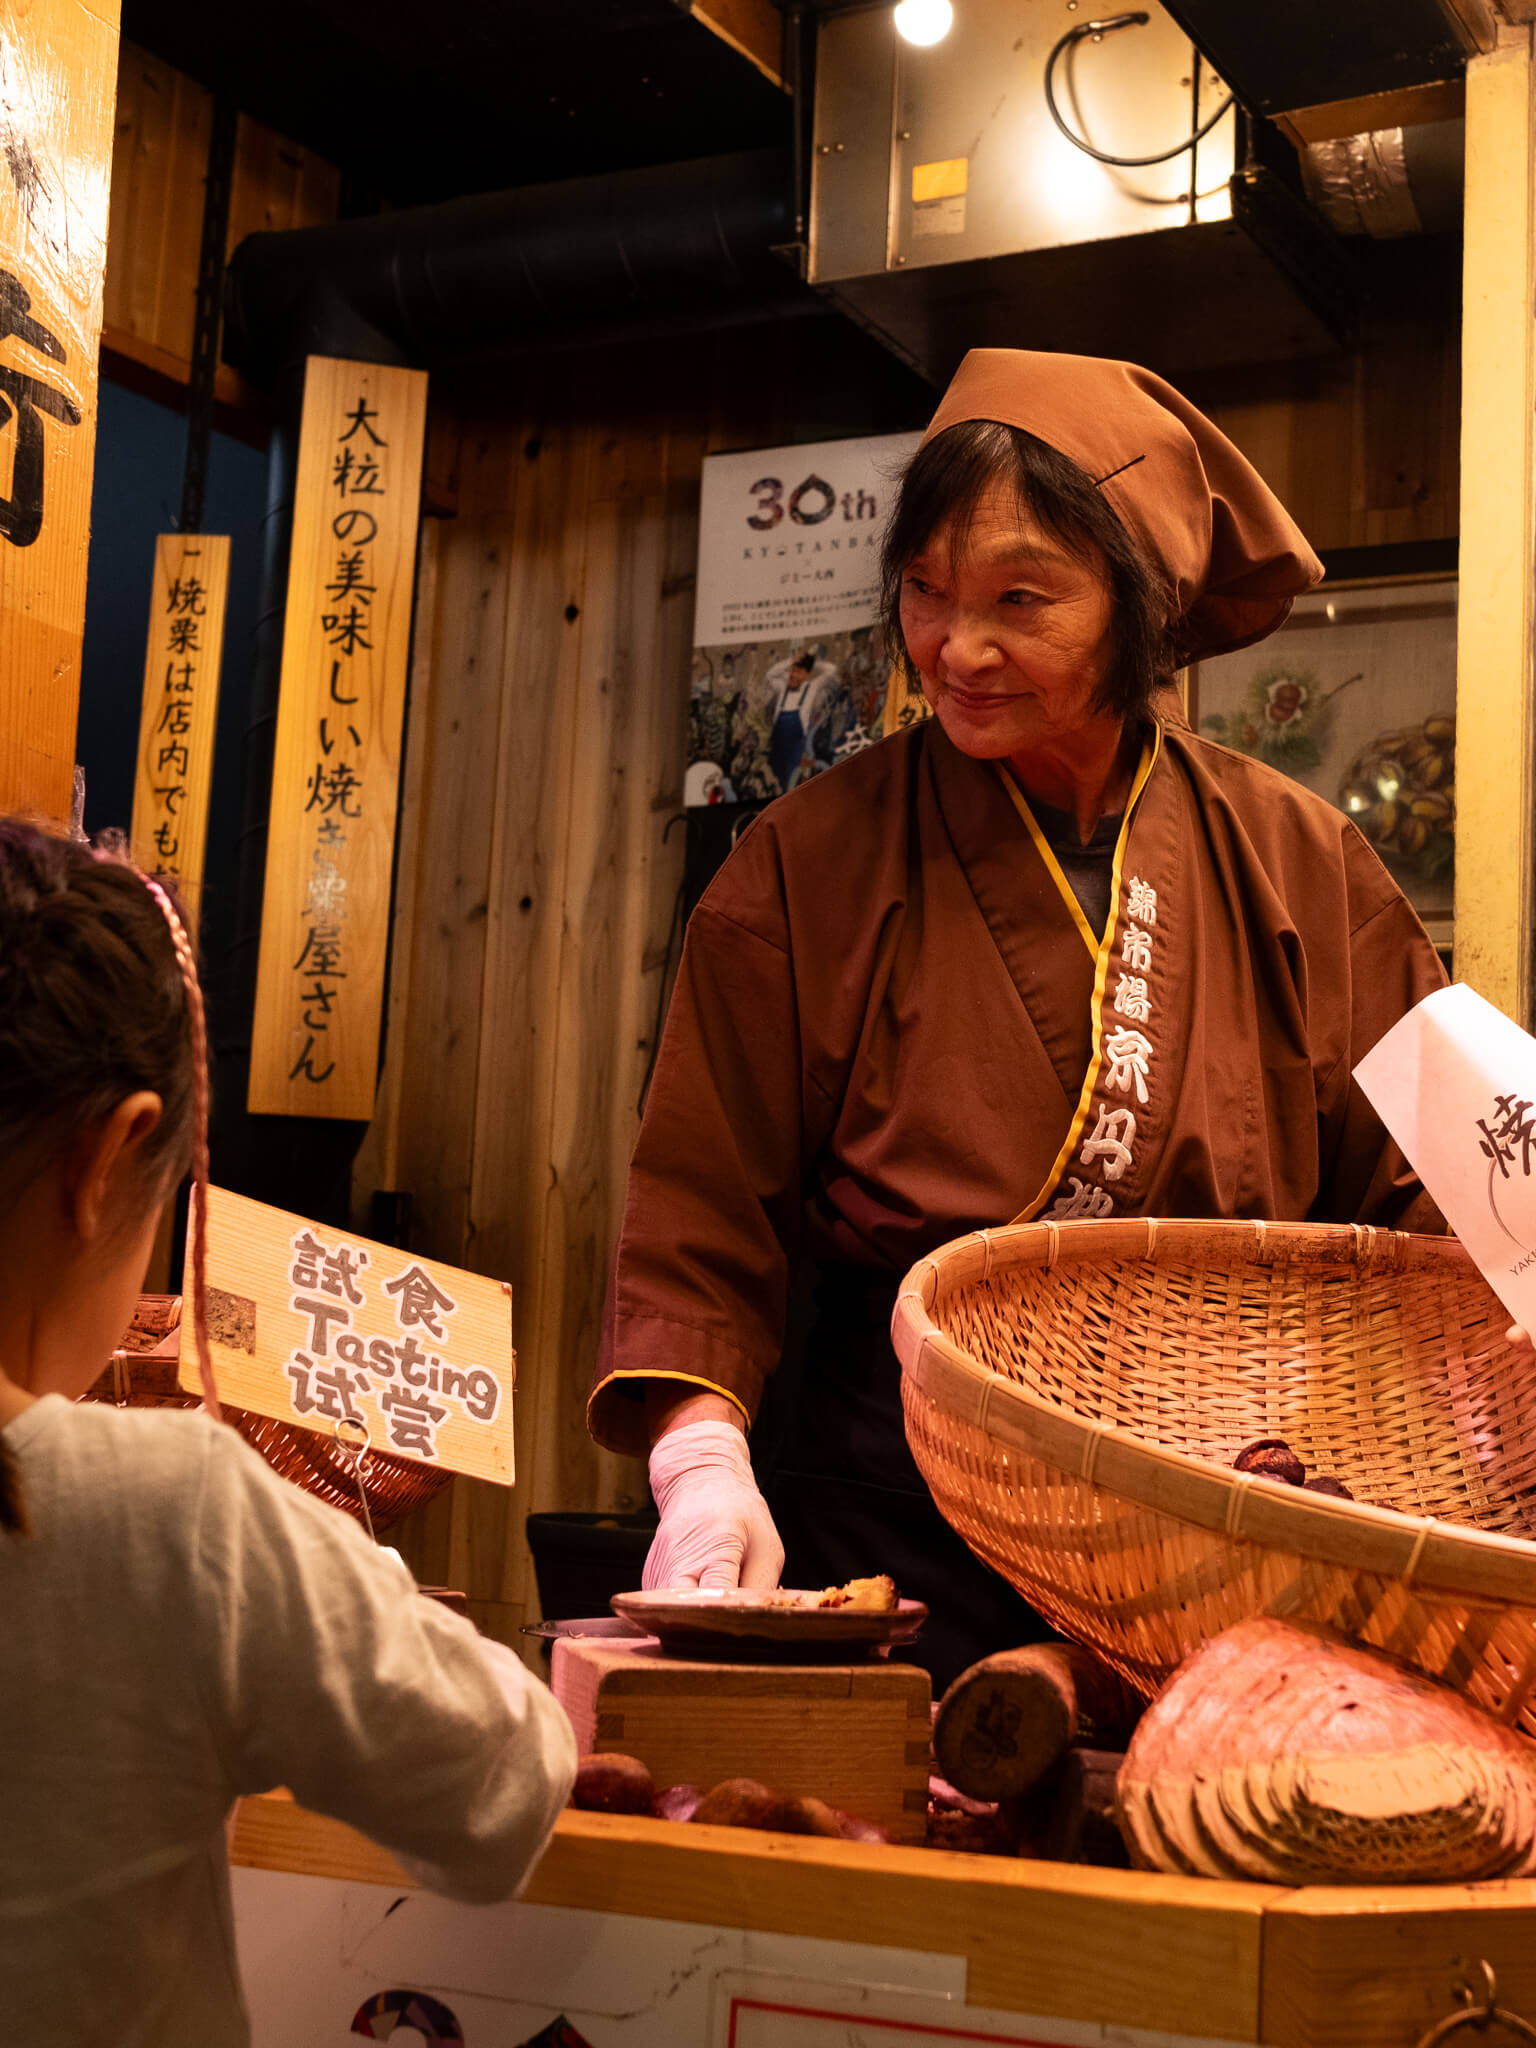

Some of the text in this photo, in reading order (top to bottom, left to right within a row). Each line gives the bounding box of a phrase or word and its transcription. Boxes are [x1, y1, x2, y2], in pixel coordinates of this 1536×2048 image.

[746, 473, 876, 531] 30th
[153, 551, 207, 875] 一焼栗は店内でも
[292, 1232, 455, 1339] 試食
[293, 1296, 499, 1421] Tasting
